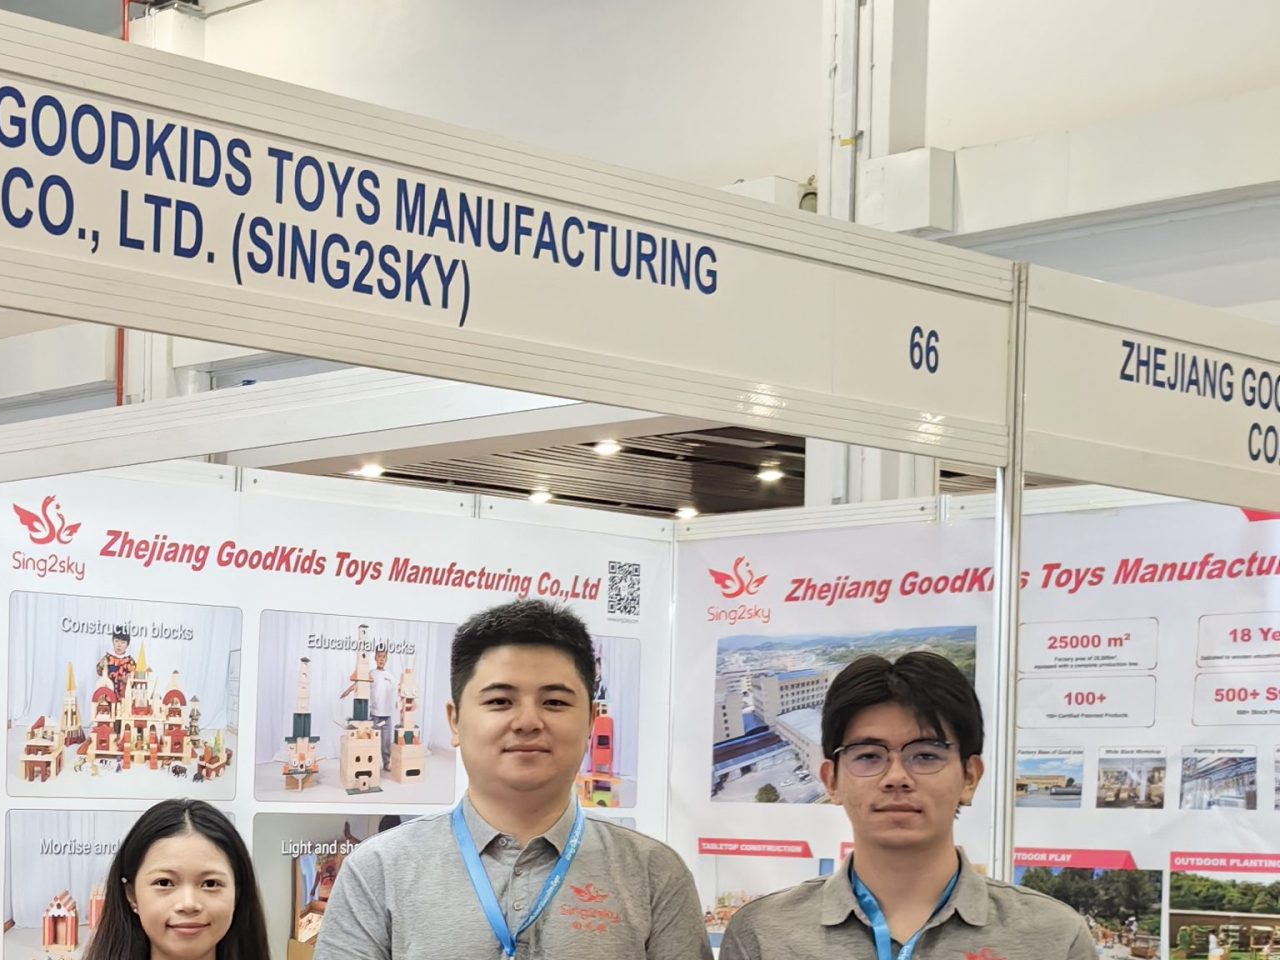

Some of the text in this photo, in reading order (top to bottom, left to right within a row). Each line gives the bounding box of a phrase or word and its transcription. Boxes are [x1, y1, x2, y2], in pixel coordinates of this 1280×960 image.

[267, 146, 379, 225] TOYS
[395, 177, 718, 295] MANUFACTURING
[1, 166, 470, 327] CO., LTD. (SING2SKY)
[909, 325, 939, 374] 66
[1120, 340, 1234, 402] ZHEJIANG
[1248, 422, 1280, 465] CO
[12, 551, 86, 580] Sing2sky
[99, 529, 602, 603] Zhejiang GoodKids Toys Manufacturing Co.,Ltd
[783, 575, 892, 607] Zhejiang
[899, 566, 1030, 597] GoodKs
[1040, 562, 1106, 595] Toys
[707, 604, 771, 625] Sing2sky
[61, 616, 194, 640] Construction blocks
[1229, 627, 1280, 643] 18 Ye
[307, 634, 415, 655] Educational blocks
[1047, 635, 1101, 650] 25000
[1064, 692, 1107, 705] 100+
[1214, 686, 1280, 703] 500+ S
[40, 839, 92, 855] Mortise
[281, 839, 313, 858] Light
[314, 839, 337, 855] and
